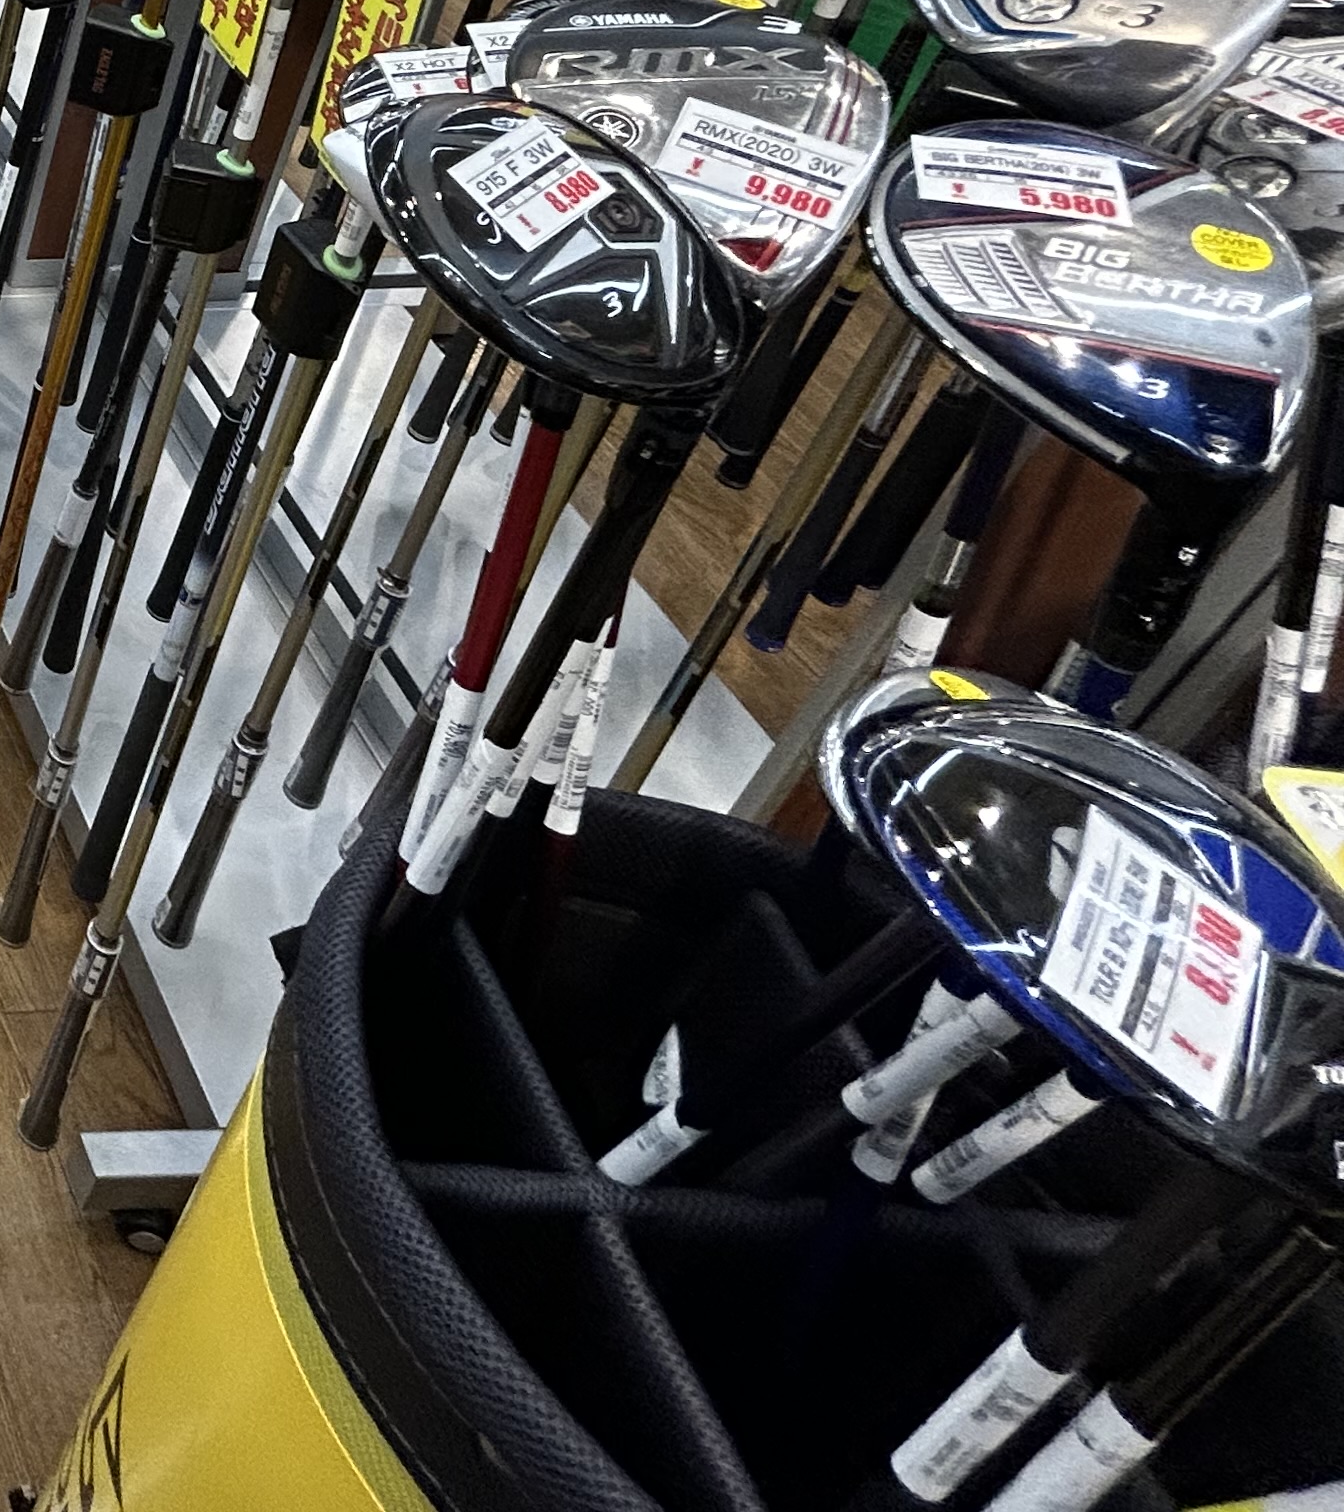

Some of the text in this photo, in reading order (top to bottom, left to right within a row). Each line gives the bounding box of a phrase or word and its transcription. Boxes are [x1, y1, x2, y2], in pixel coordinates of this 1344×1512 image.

[592, 12, 674, 27] YAMAHA
[756, 14, 803, 35] 3
[1118, 3, 1165, 29] 3
[395, 57, 458, 72] X2 HOT
[693, 118, 803, 166] RMX(2020)
[808, 154, 846, 179] 3W
[931, 150, 959, 163] BIG
[1076, 166, 1101, 179] 3W
[475, 168, 509, 197] 915
[504, 159, 520, 177] F
[523, 139, 556, 166] 3W
[543, 169, 601, 214] 8,980
[744, 174, 834, 220] 9,980
[1018, 186, 1118, 218] 5,980
[1043, 236, 1131, 270] BIG
[1052, 261, 1266, 315] BERTHA
[1136, 378, 1171, 400] 3
[1184, 901, 1243, 1006] 8,80
